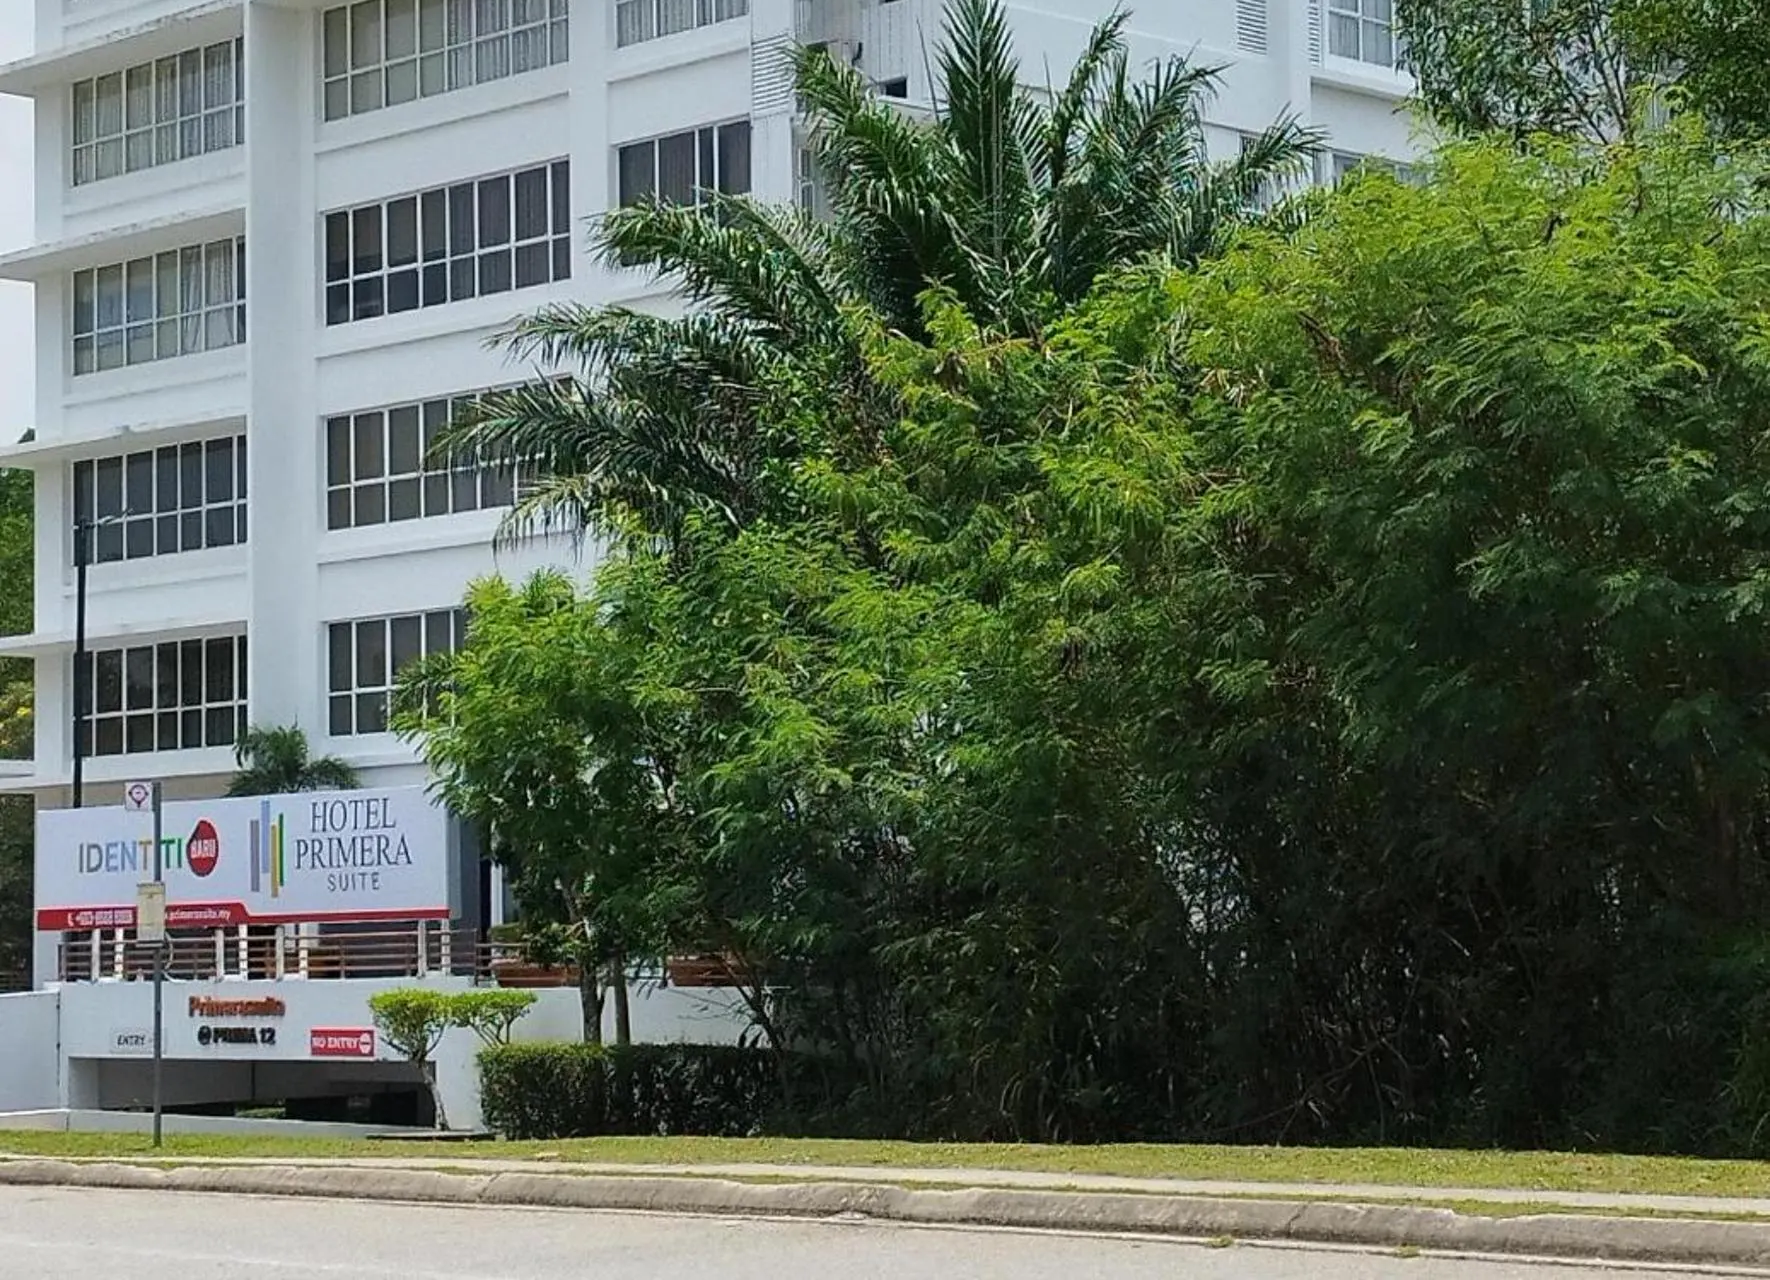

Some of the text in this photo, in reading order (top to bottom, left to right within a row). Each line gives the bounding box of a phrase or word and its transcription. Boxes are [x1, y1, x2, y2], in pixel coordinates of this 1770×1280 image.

[311, 797, 396, 833] HOTEL
[78, 837, 184, 874] IDENTTI
[295, 832, 412, 870] PRIMERA
[327, 871, 381, 893] SUITE
[117, 1033, 147, 1046] ENTRY
[260, 1026, 277, 1045] 12
[311, 1034, 360, 1049] NO ENTRY
